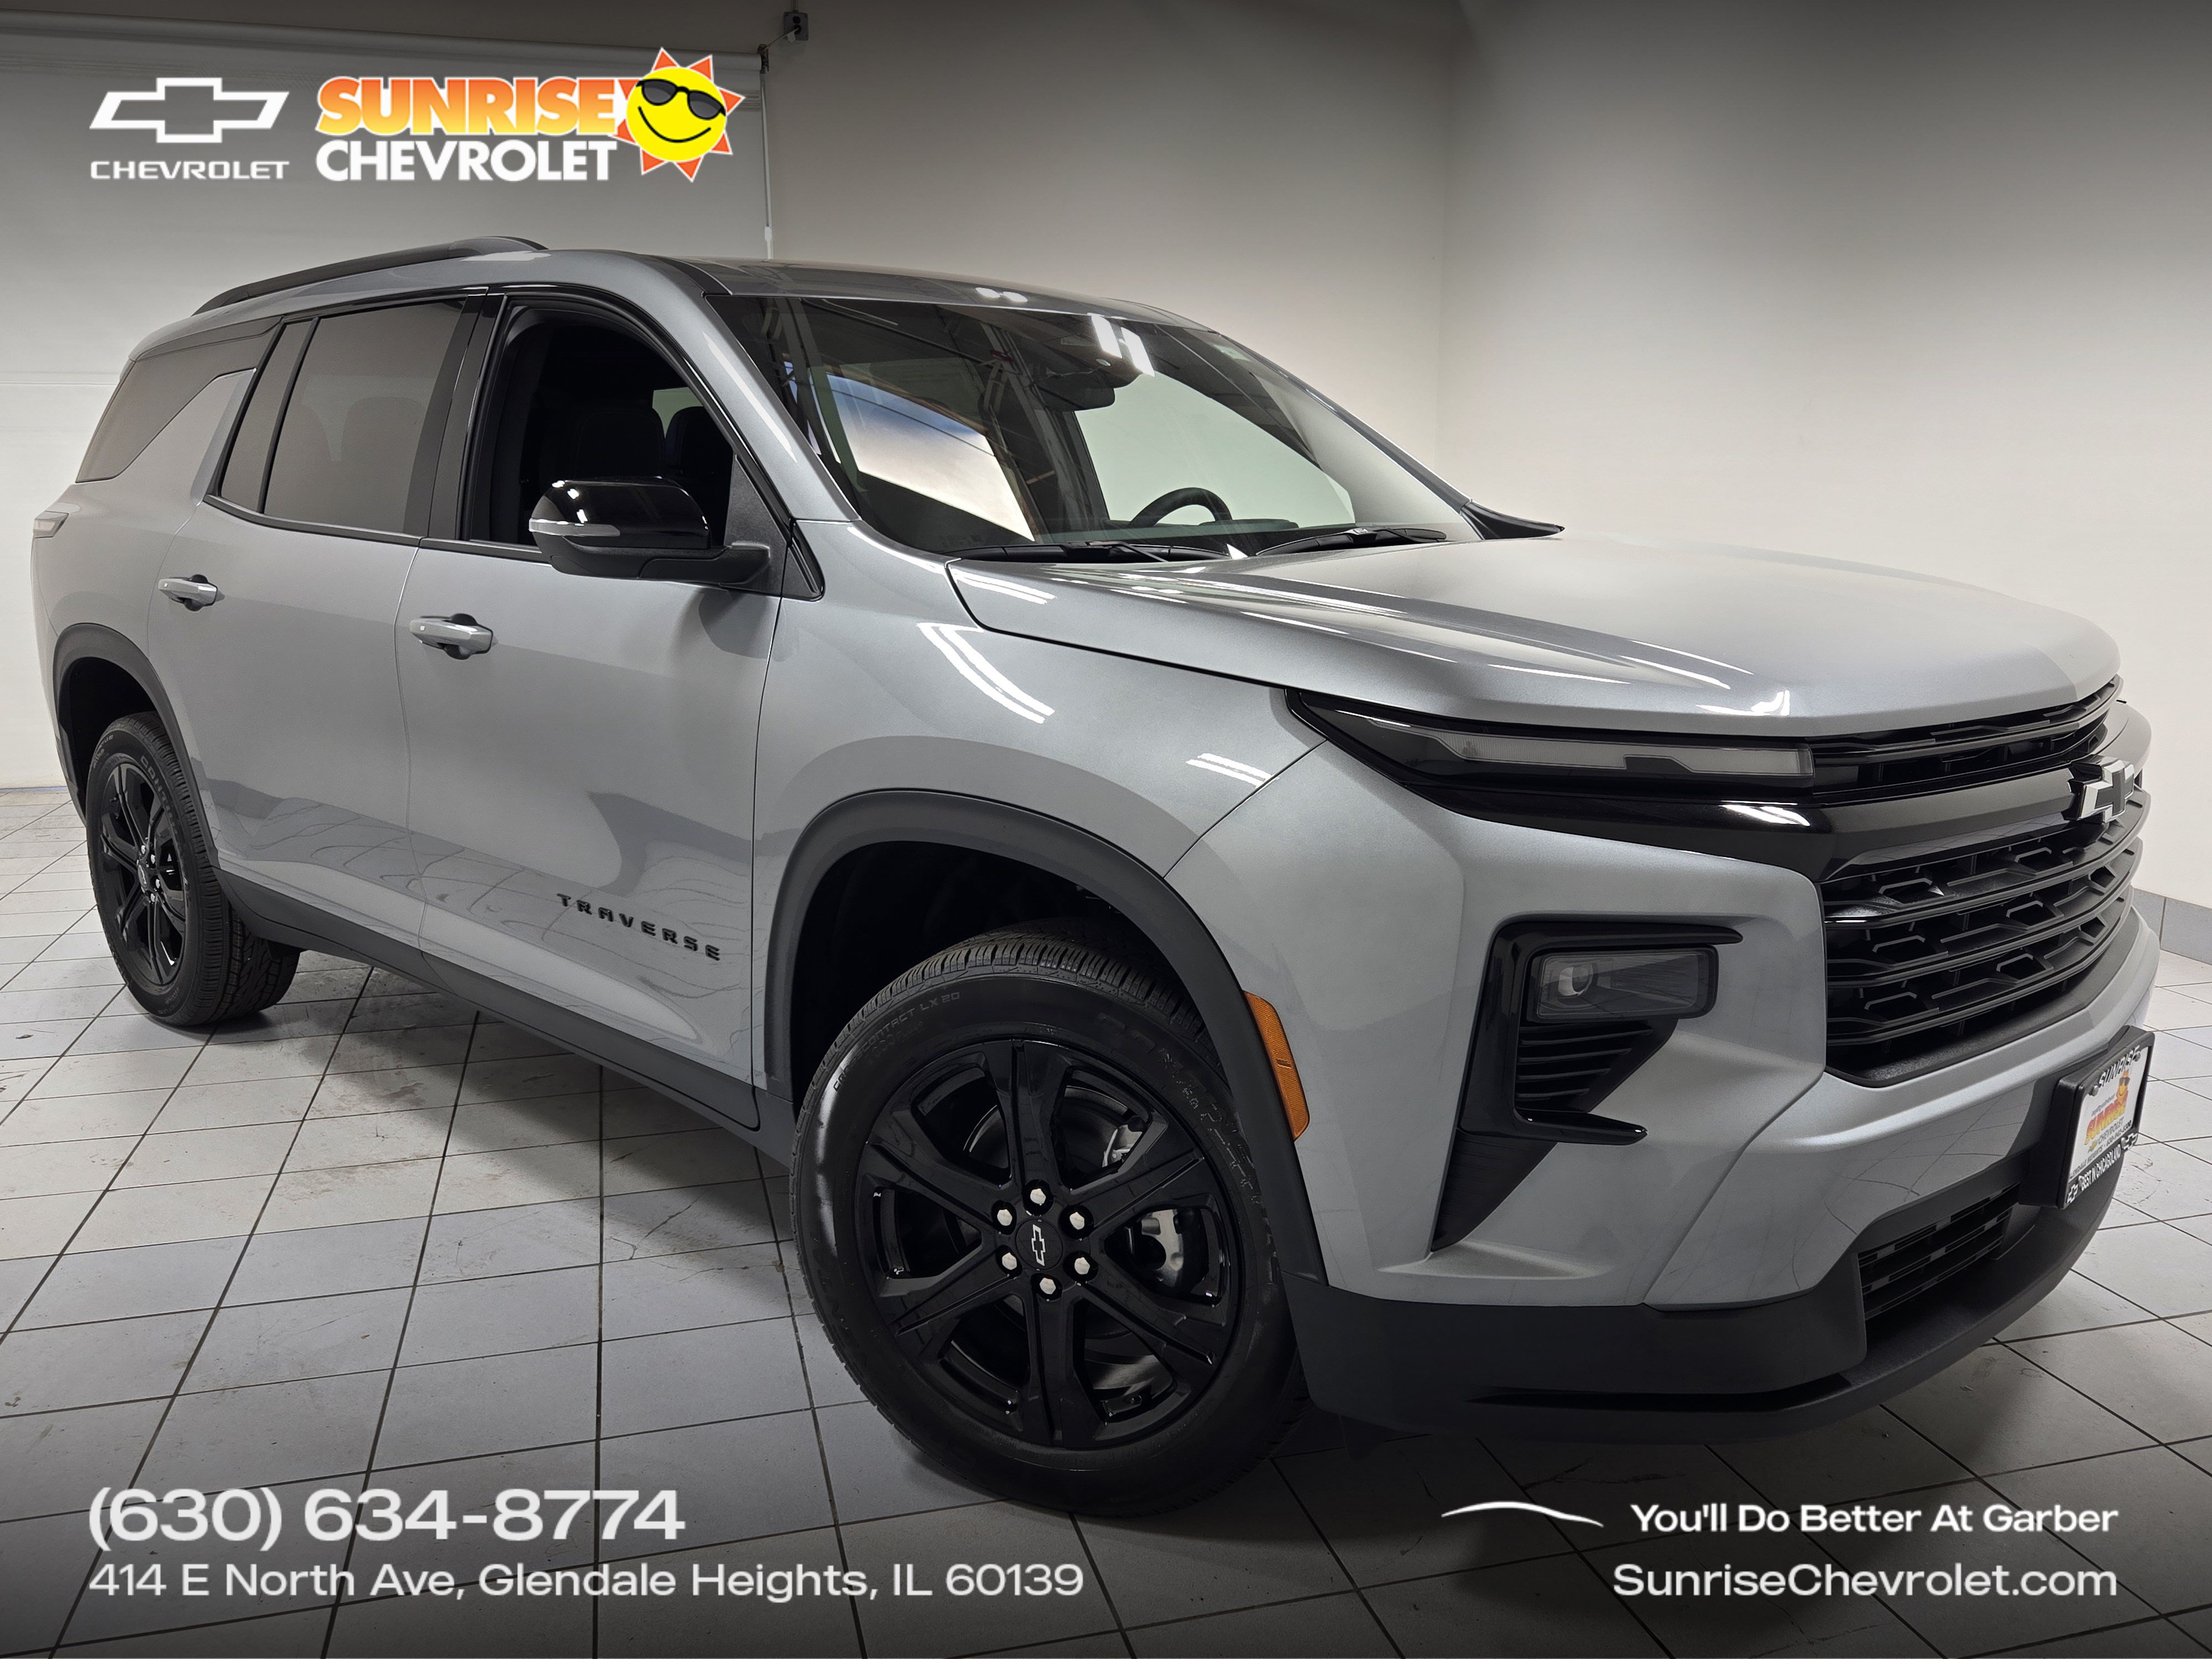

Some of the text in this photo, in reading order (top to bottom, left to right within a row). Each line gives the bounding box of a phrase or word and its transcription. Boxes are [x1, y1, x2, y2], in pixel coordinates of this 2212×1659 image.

[557, 893, 721, 961] TRAVERSE
[920, 998, 939, 1011] LX
[941, 992, 960, 1004] 20
